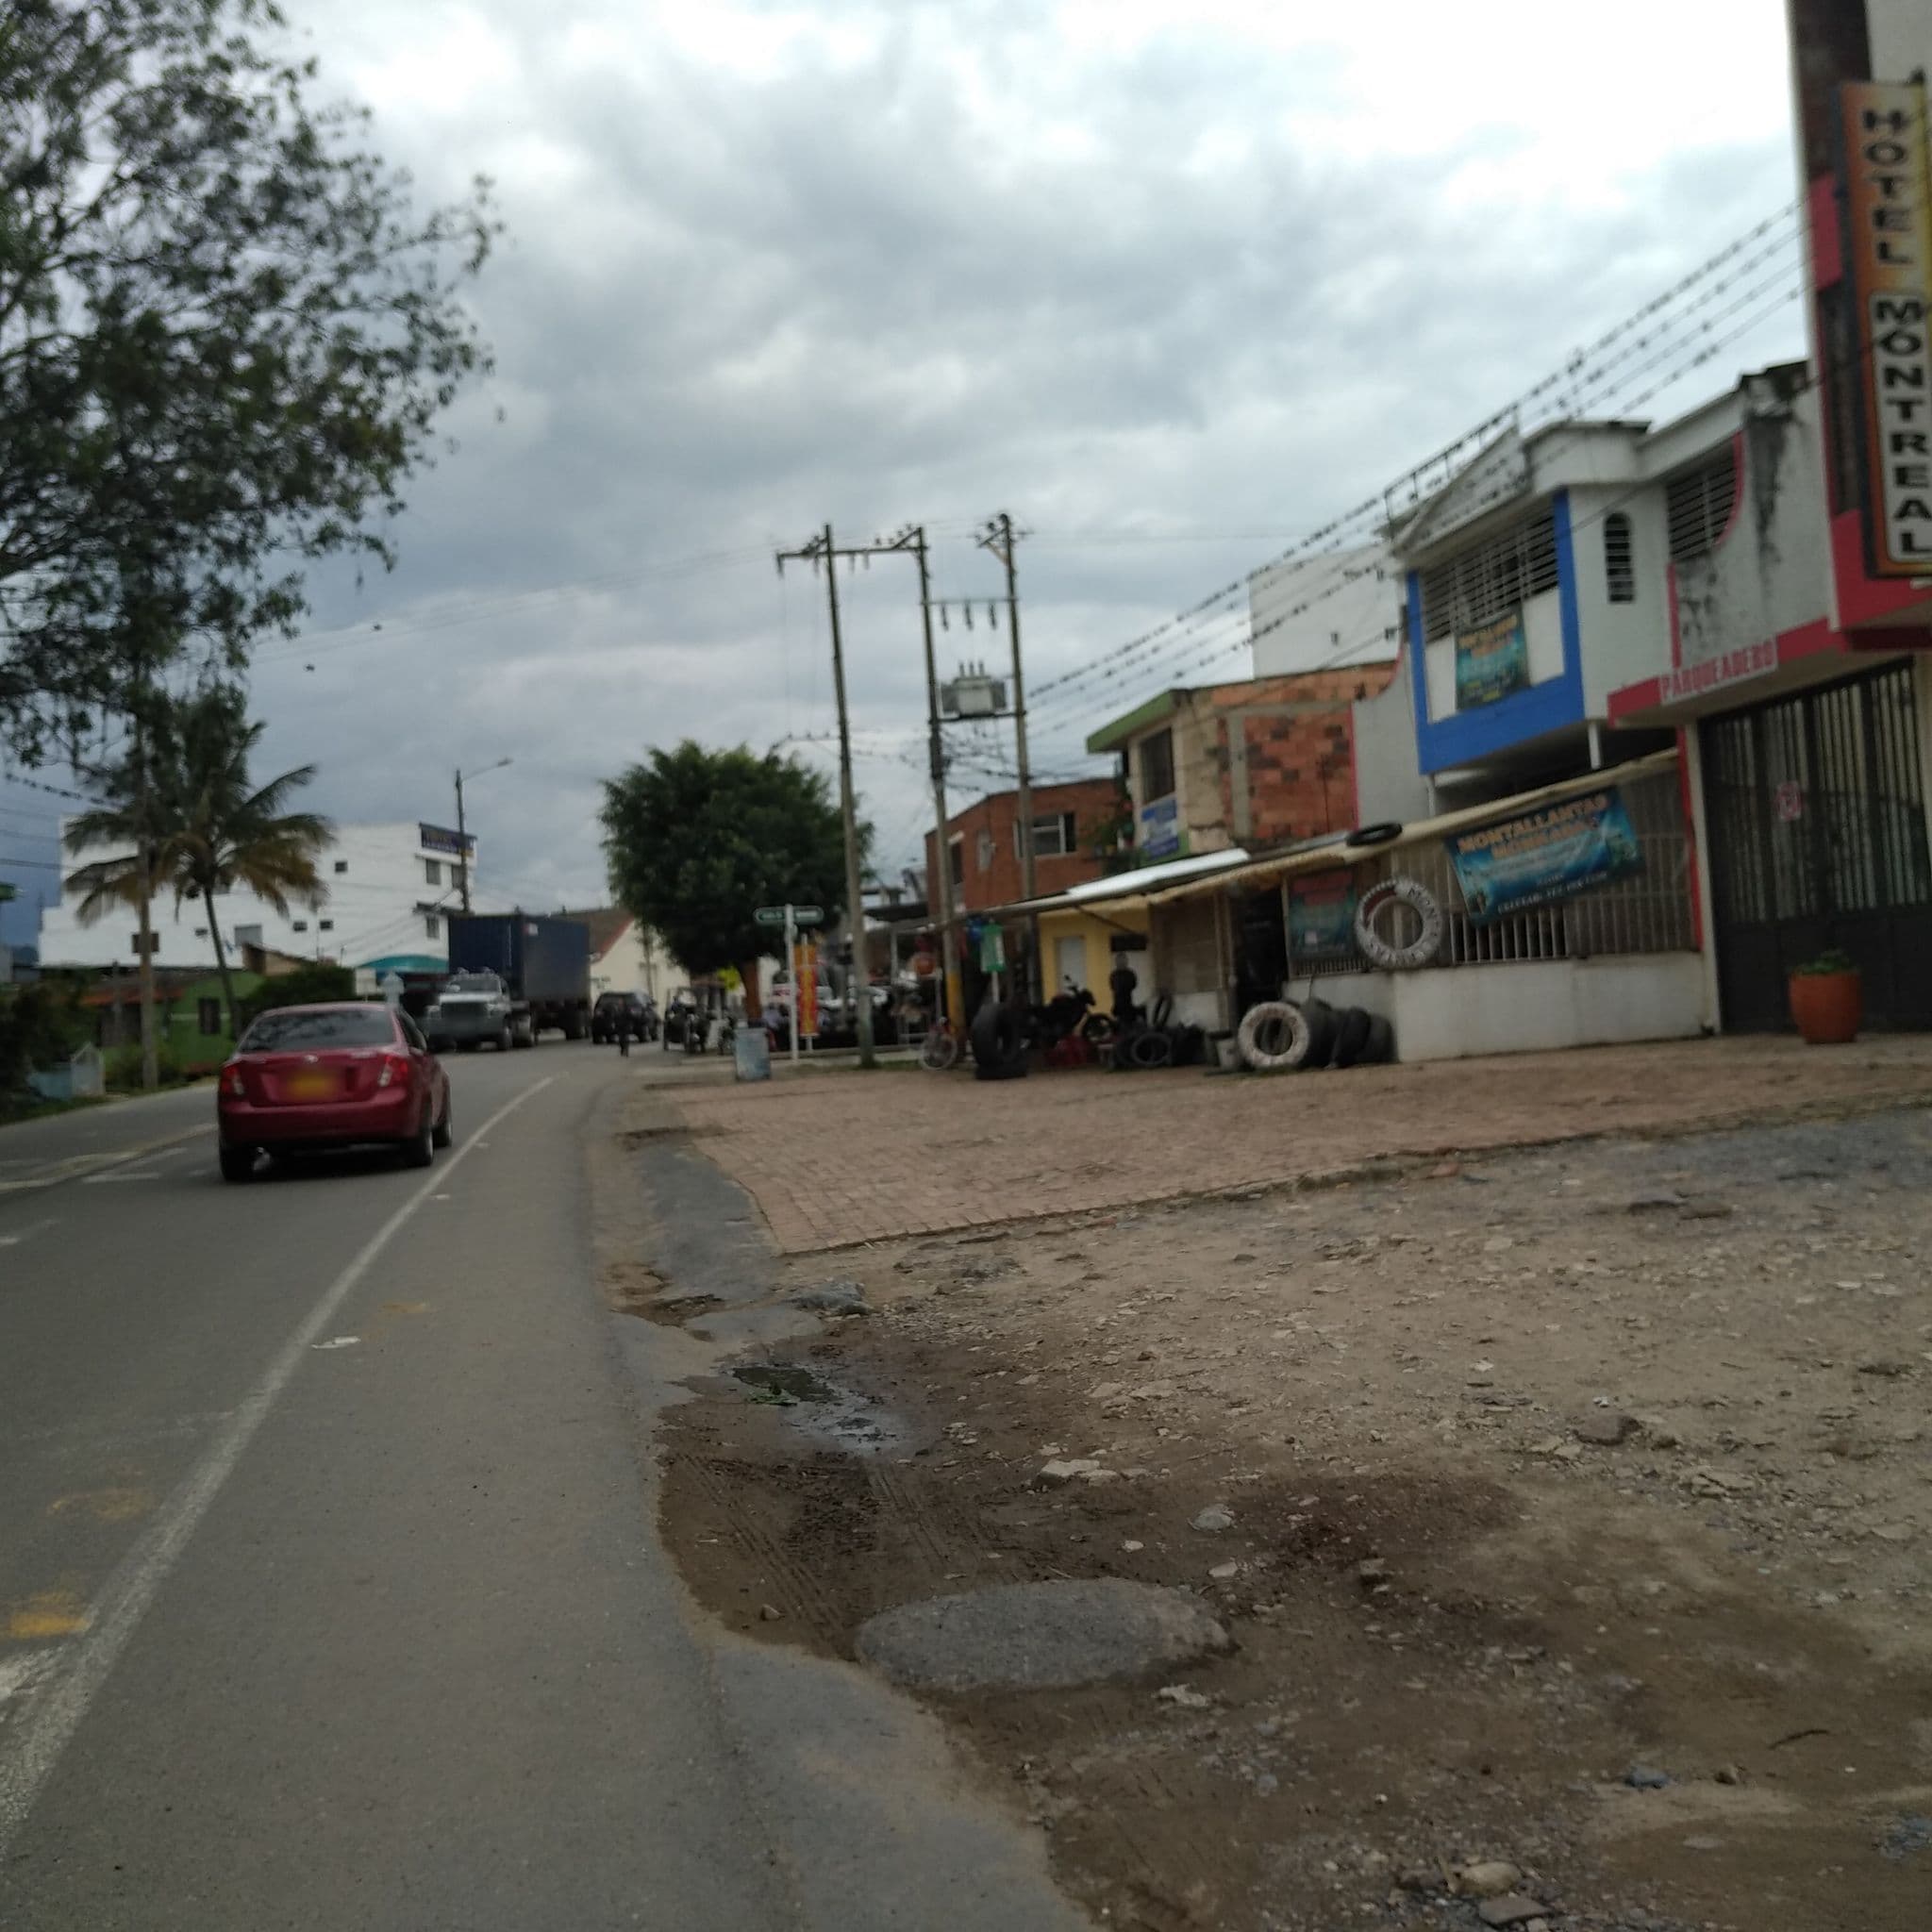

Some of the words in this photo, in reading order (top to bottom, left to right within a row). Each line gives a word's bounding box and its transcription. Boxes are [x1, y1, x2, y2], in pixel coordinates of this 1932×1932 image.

[1861, 108, 1913, 265] HOTEL
[1874, 299, 1932, 555] MONTREAL
[1661, 640, 1776, 701] PARQUEADERO
[1457, 793, 1608, 854] MONTALLANTAS
